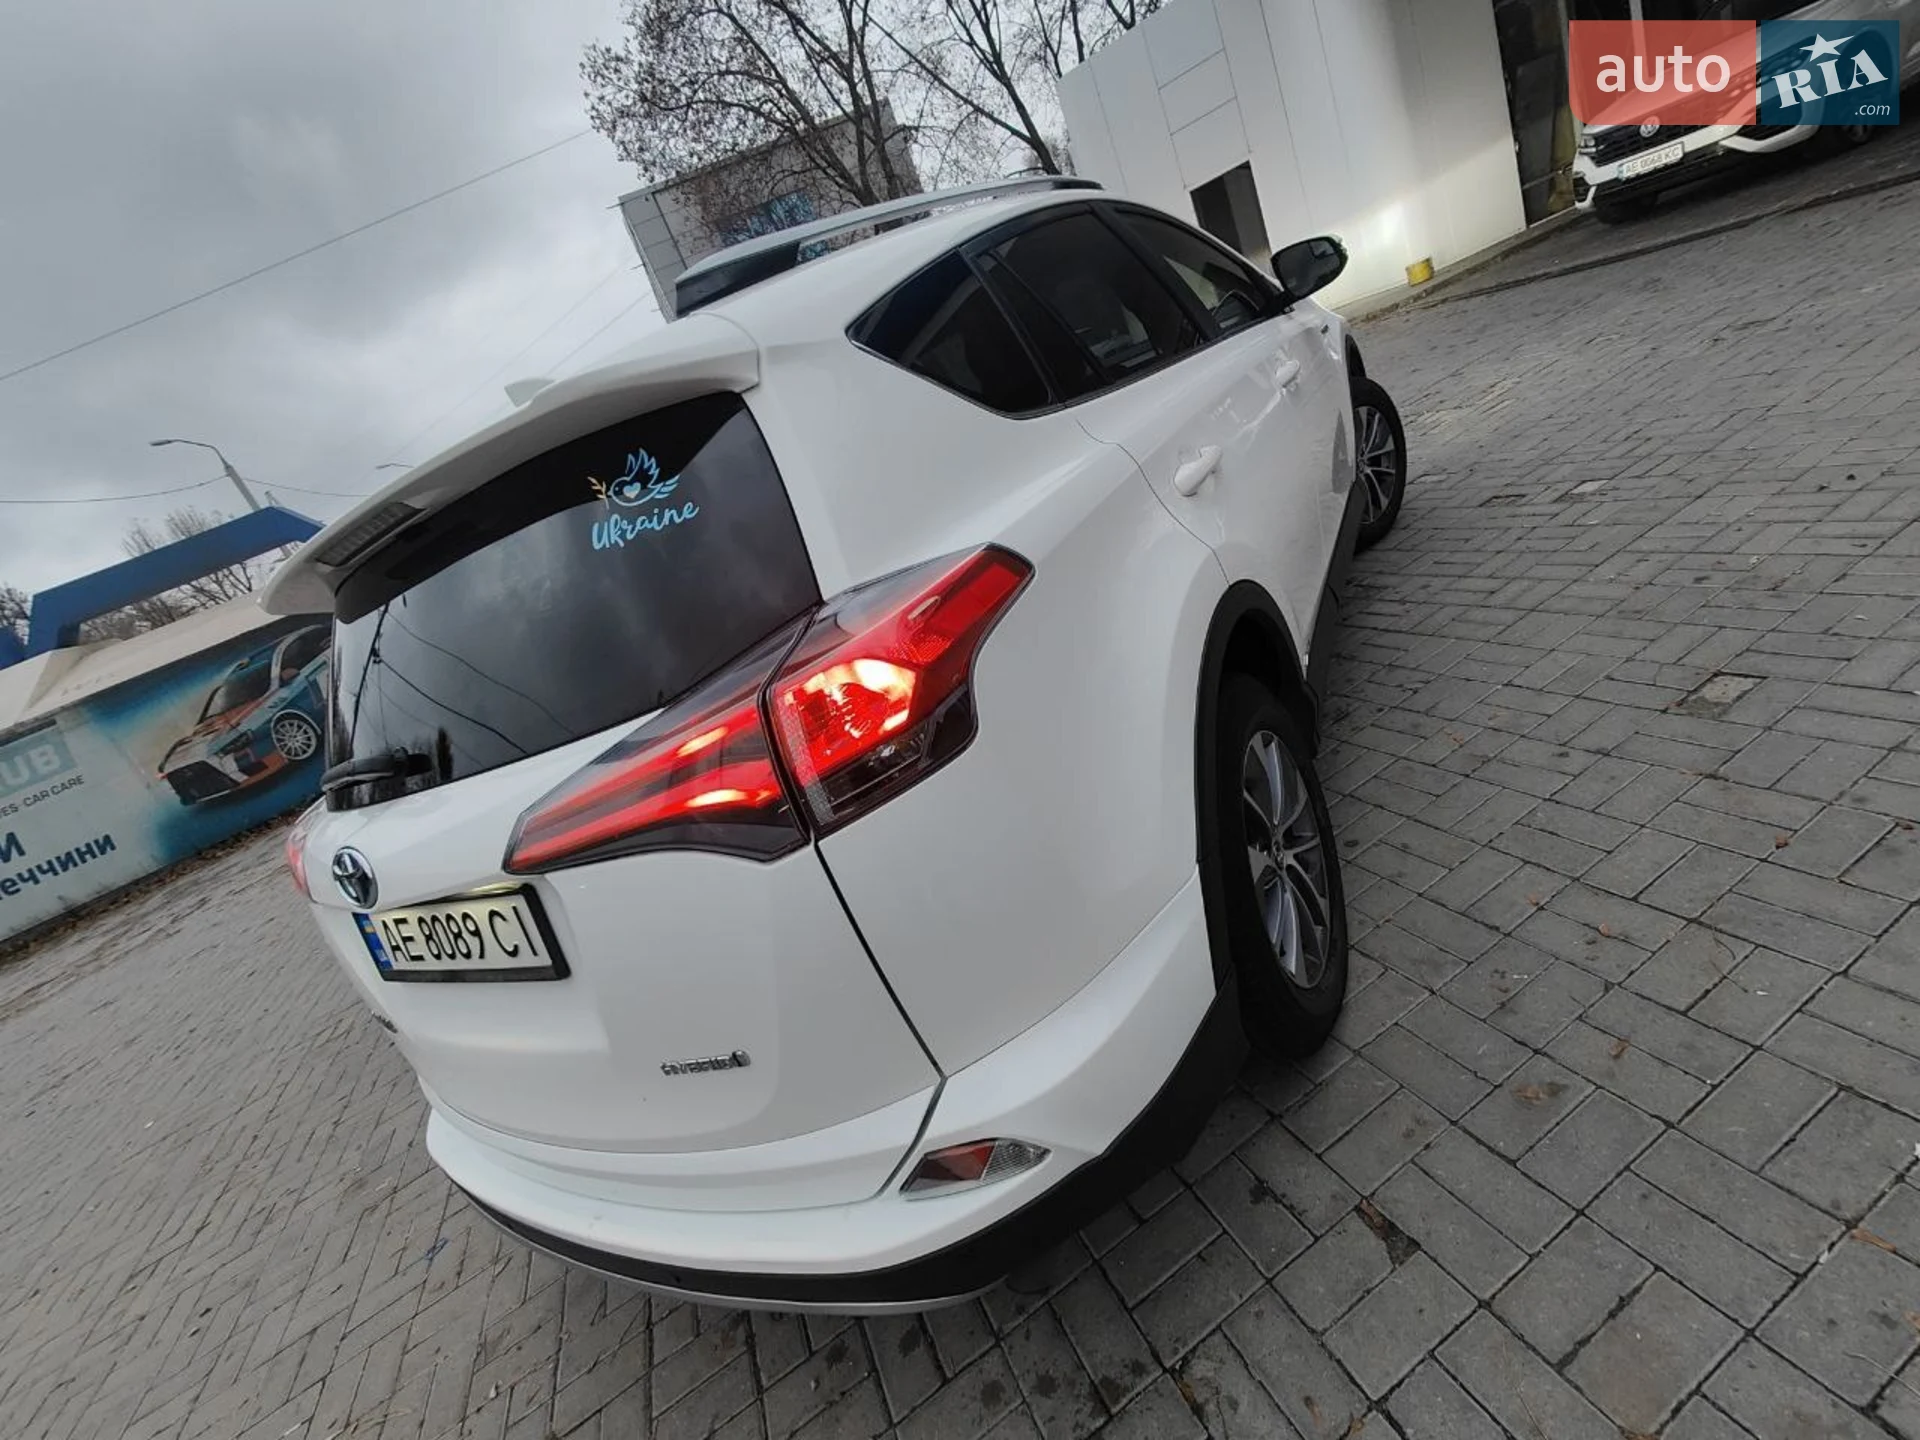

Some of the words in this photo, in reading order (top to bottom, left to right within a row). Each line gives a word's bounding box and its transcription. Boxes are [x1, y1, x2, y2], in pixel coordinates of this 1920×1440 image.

[592, 501, 700, 550] Ukraine
[0, 744, 60, 789] UB
[0, 803, 19, 819] ES
[23, 790, 50, 807] CAR
[50, 775, 85, 795] CARE
[0, 833, 117, 900] еччини
[382, 917, 425, 962] AE
[417, 912, 485, 961] 8089
[488, 905, 538, 959] CI
